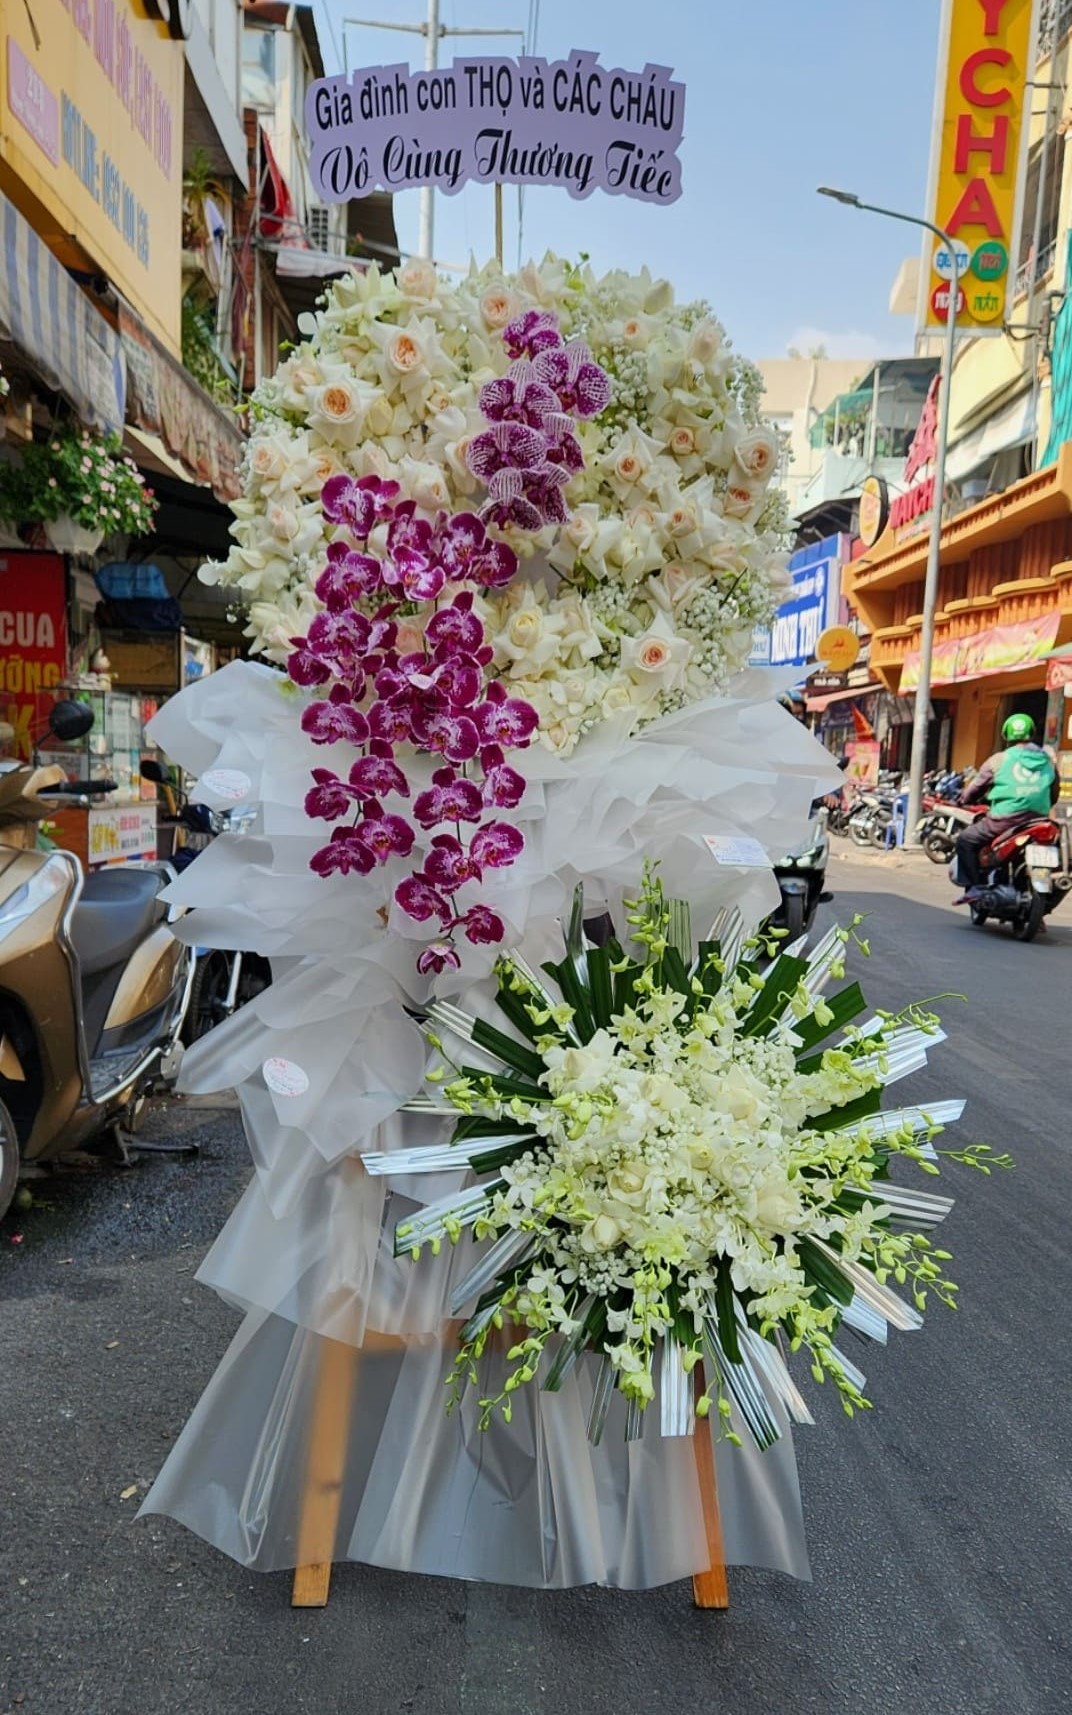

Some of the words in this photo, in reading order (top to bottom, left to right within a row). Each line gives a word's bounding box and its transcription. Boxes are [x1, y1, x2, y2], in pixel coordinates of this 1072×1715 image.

[315, 86, 353, 131] Gia
[360, 73, 409, 121] đình
[416, 76, 456, 111] con
[464, 66, 512, 117] THỌ
[520, 65, 545, 109] và
[553, 60, 601, 117] CÁC
[609, 74, 675, 131] CHÁU
[320, 144, 372, 194] Vô
[382, 134, 464, 187] Cùng
[474, 128, 596, 191] Thương
[605, 140, 673, 197] Tiếc
[0, 611, 55, 648] CUA
